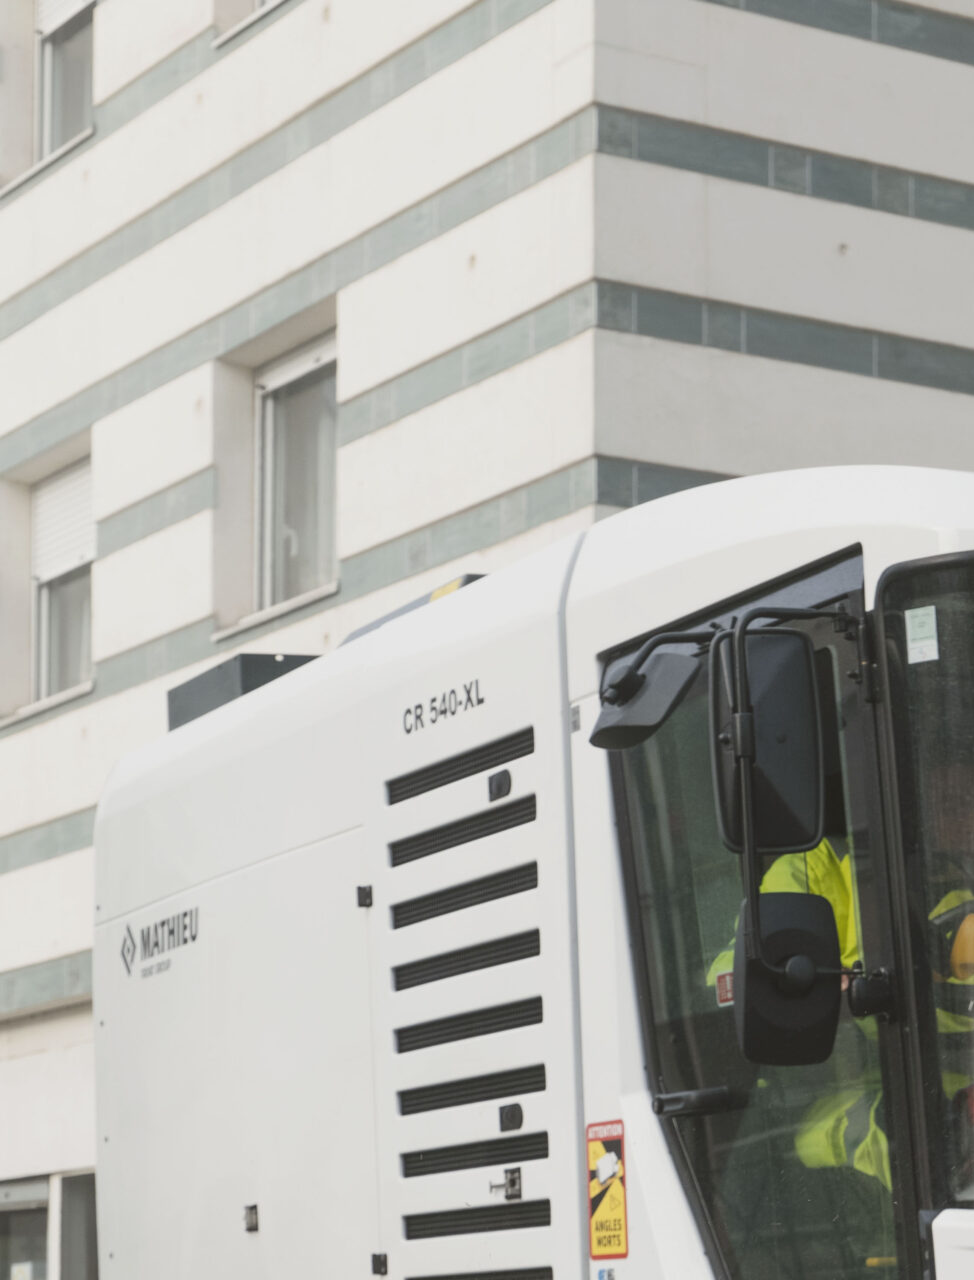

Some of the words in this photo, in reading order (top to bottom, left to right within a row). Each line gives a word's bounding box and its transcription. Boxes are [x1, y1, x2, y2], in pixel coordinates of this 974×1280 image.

[403, 703, 424, 734] CR
[430, 679, 485, 724] 540-XL
[140, 906, 199, 961] MATHIEU
[595, 1218, 622, 1232] ANGLES
